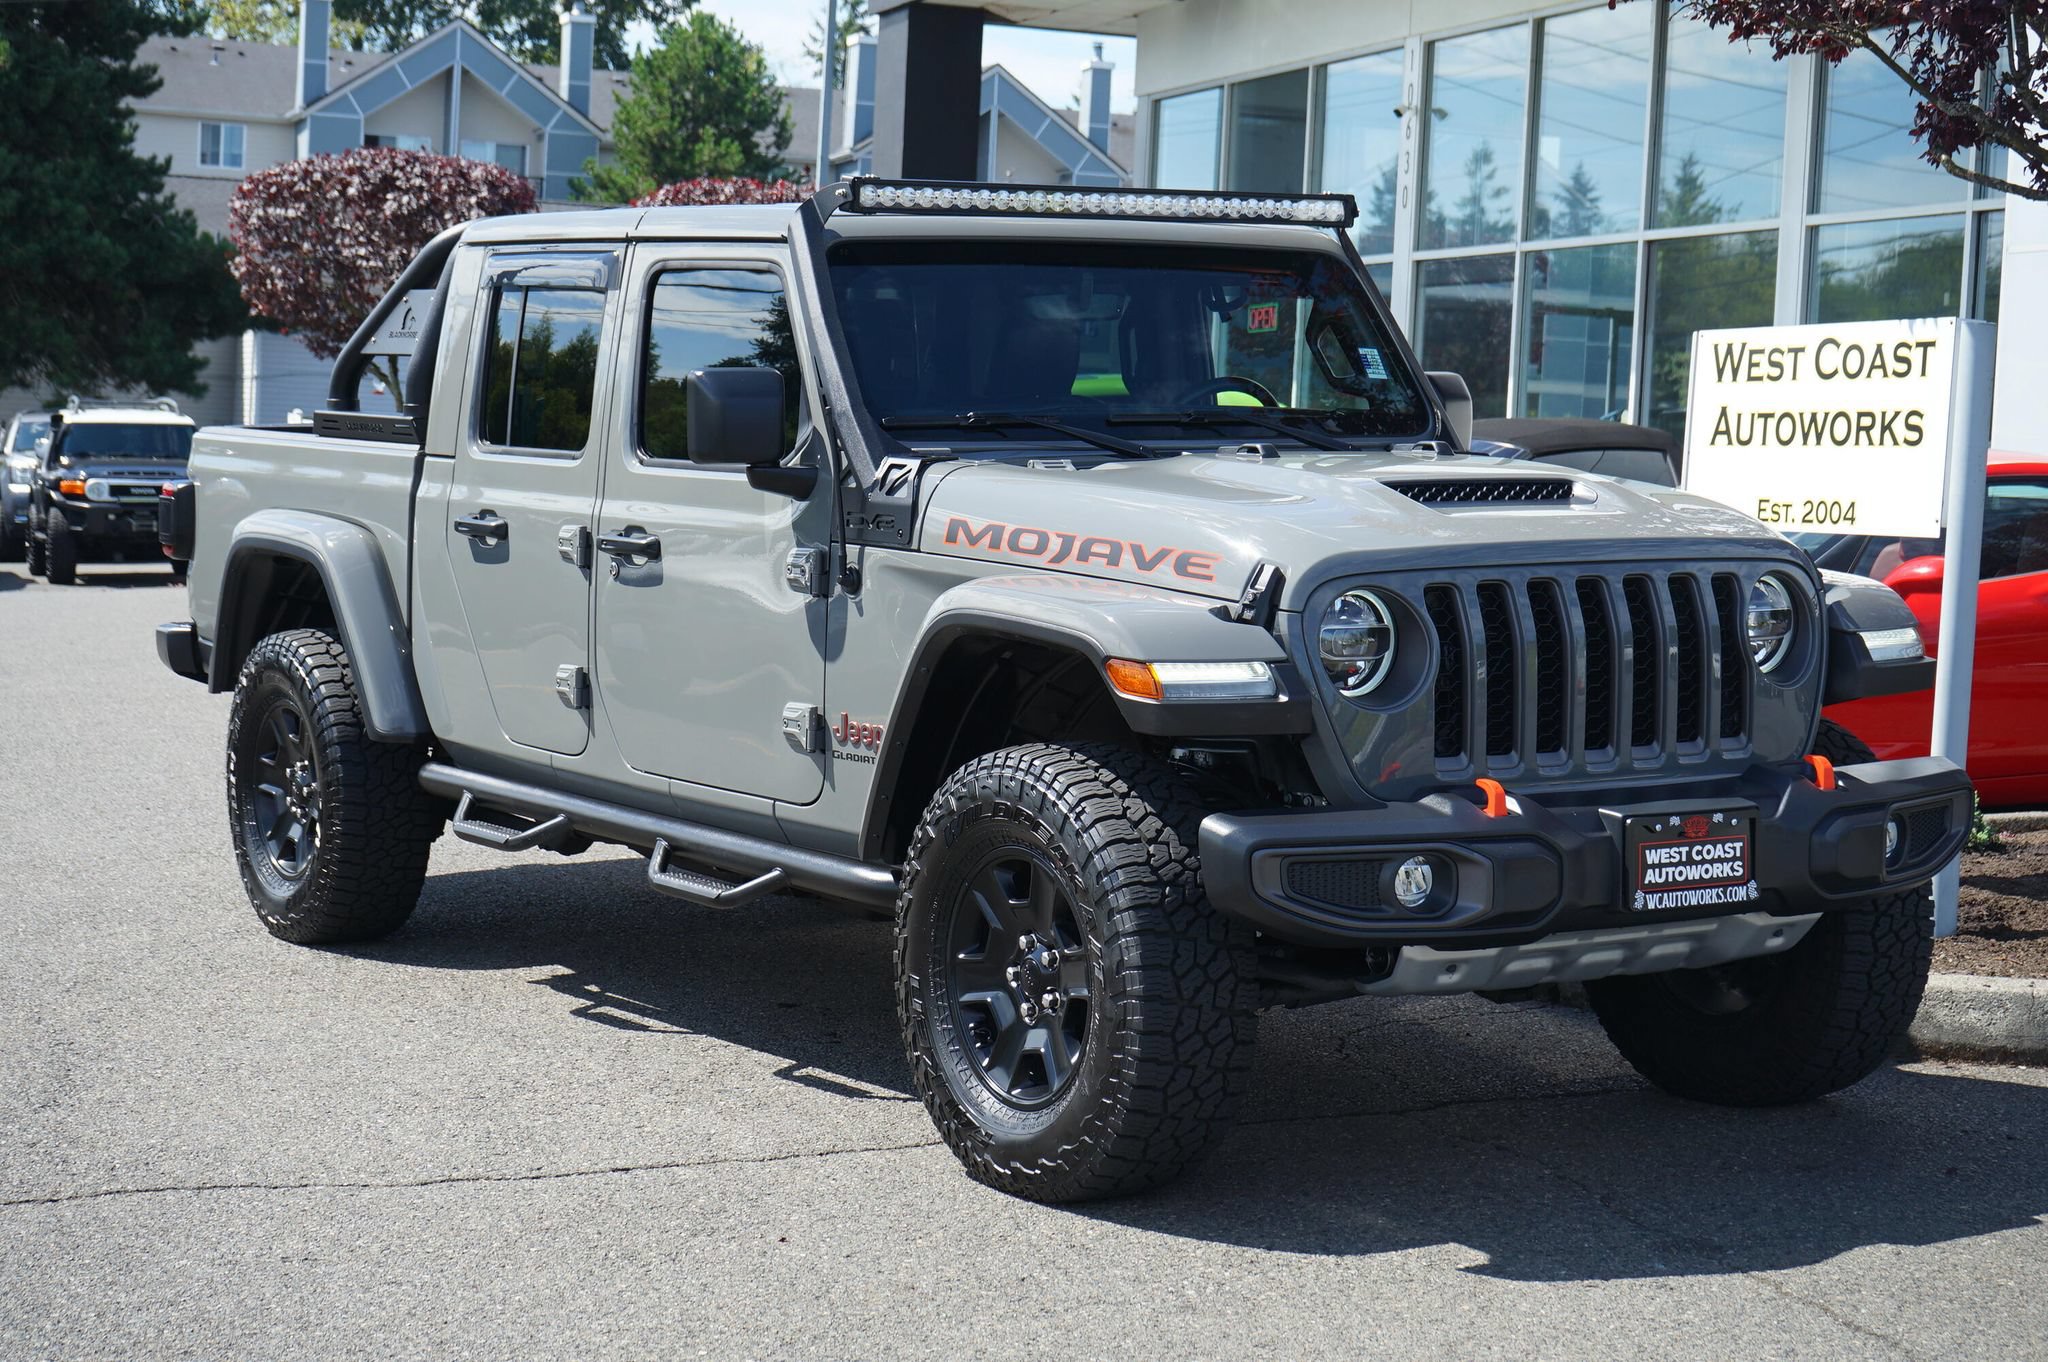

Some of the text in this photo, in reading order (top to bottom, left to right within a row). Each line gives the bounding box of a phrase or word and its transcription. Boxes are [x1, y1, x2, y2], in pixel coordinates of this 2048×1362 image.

[1250, 307, 1275, 329] OPEN
[1801, 500, 1857, 525] 2004
[943, 516, 1223, 583] MOJAVE
[832, 711, 884, 756] Jeep
[832, 750, 877, 765] GLADIAT
[1645, 841, 1743, 865] WEST COAST
[1644, 861, 1744, 884] AUTOWORKS
[1646, 886, 1747, 910] WCAUTOWORKS.COM
